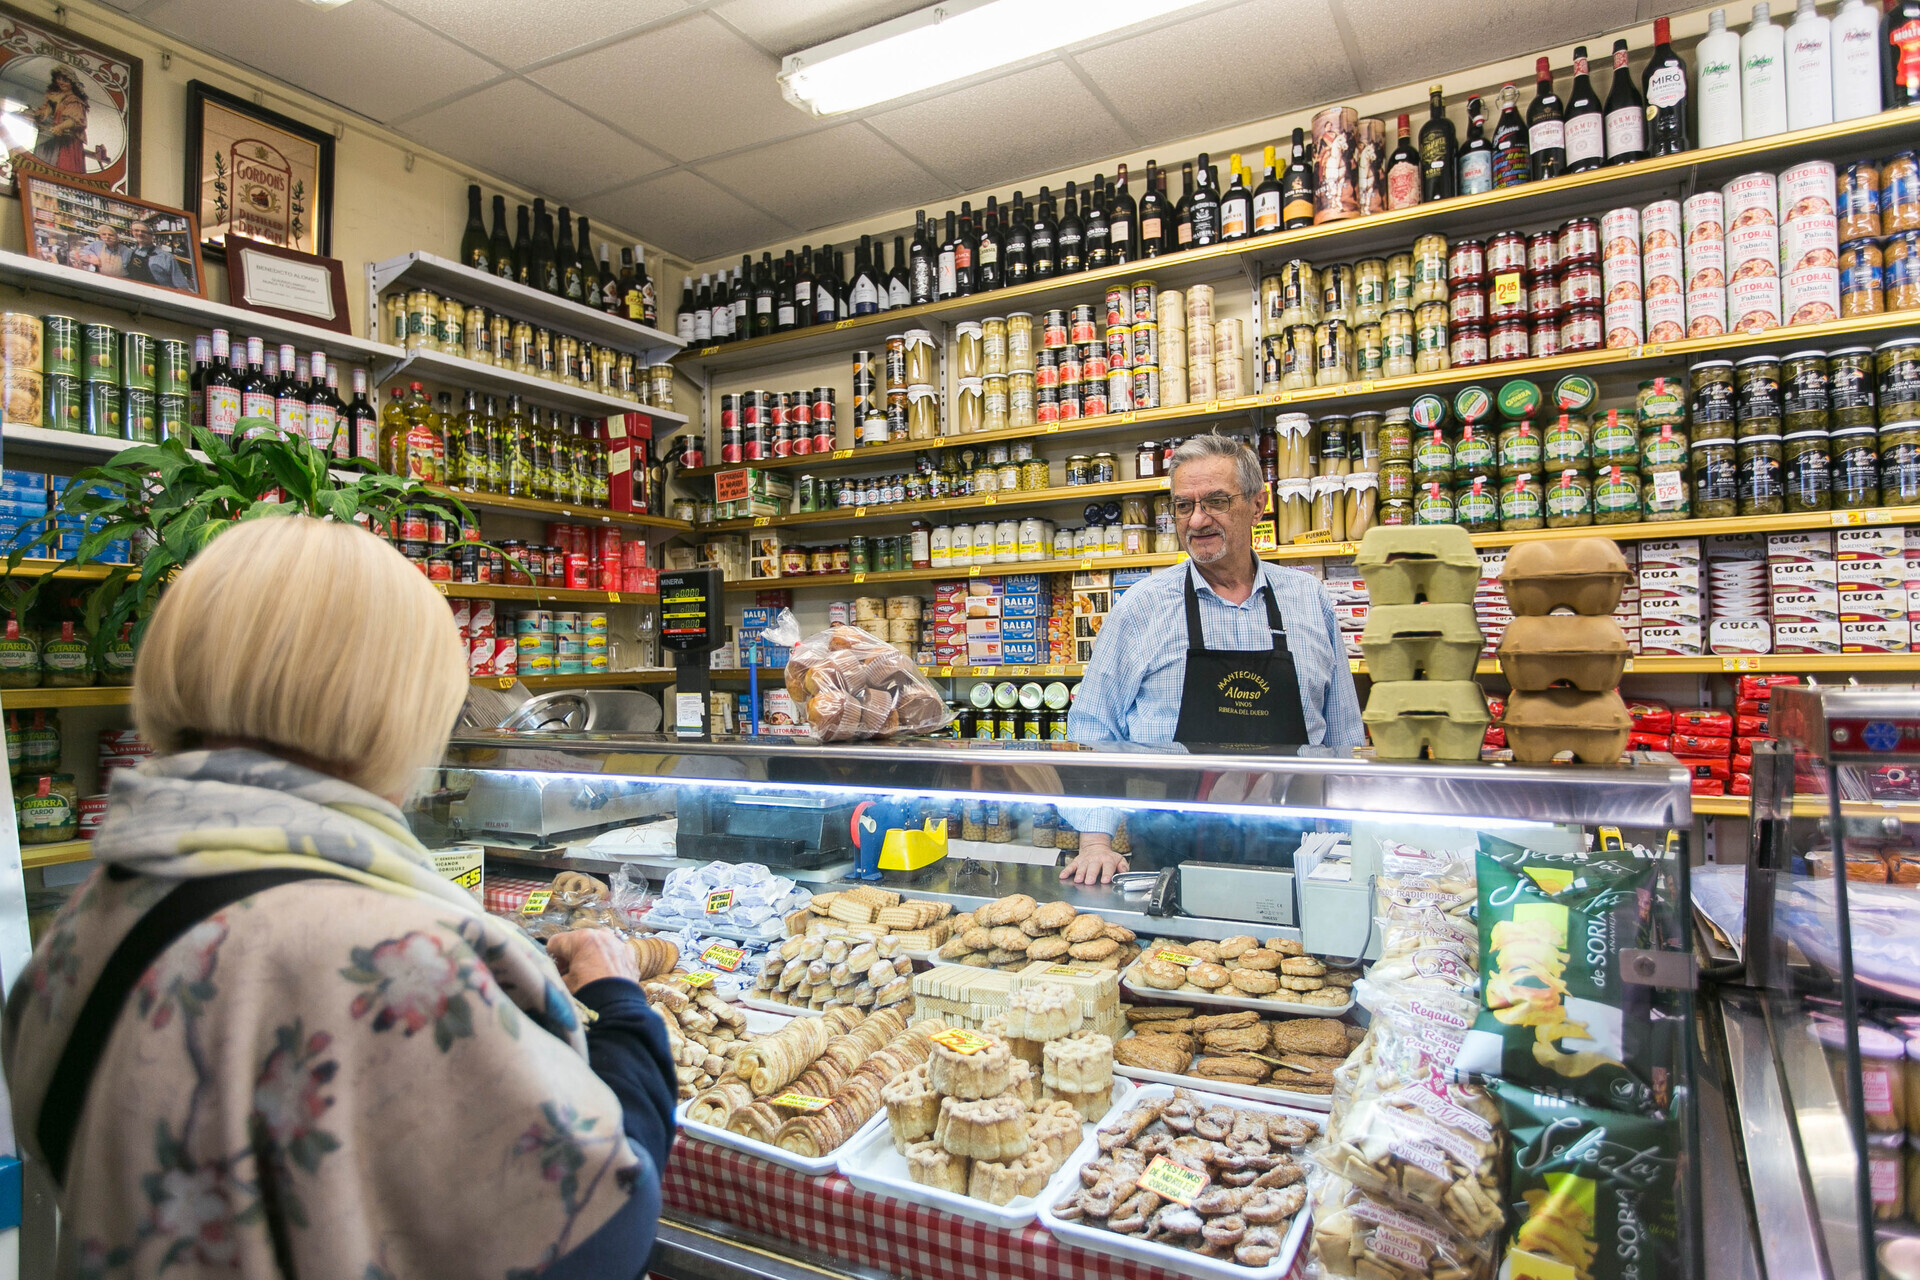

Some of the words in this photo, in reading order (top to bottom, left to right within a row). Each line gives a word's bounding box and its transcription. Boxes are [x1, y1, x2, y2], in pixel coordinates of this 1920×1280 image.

[1652, 73, 1681, 88] MIRÓ
[237, 160, 285, 191] GORDON'S
[1786, 167, 1829, 182] LITORAL
[1731, 178, 1771, 192] LITORAL
[1690, 197, 1721, 208] LITORAL
[240, 209, 283, 230] DISTILLED
[1796, 219, 1835, 231] LITORAL
[239, 220, 262, 237] DRY
[263, 228, 283, 245] GIN
[1732, 230, 1773, 244] LITORAL
[1691, 244, 1722, 255] LITORAL
[1790, 272, 1832, 286] LITORAL
[1734, 282, 1775, 295] LITORAL
[1648, 297, 1679, 309] LITORAL
[1687, 292, 1719, 303] LITORAL
[1305, 530, 1331, 539] PUERROS
[1769, 535, 1811, 545] CUCA
[1839, 531, 1882, 540] CUCA
[1643, 543, 1680, 551] CUCA
[1116, 567, 1149, 575] BALEA
[1774, 565, 1815, 574] CUCA
[1839, 562, 1882, 571] CUCA
[1007, 575, 1037, 583] BALEA
[1642, 571, 1679, 579] CUCA
[661, 578, 684, 586] MINERVA
[1004, 598, 1034, 606] BALEA
[1776, 595, 1816, 604] CUCA
[1842, 593, 1884, 602] CUCA
[1643, 600, 1680, 608] CUCA
[744, 610, 766, 618] BALEA
[1003, 621, 1032, 629] BALEA
[1720, 622, 1759, 630] CUCA
[1778, 626, 1819, 634] CUCA
[1844, 624, 1887, 632] CUCA
[1644, 628, 1681, 637] CUCA
[1004, 645, 1034, 653] BALEA
[1013, 667, 1029, 675] 275
[1217, 670, 1271, 694] MANTEQUERÍA
[1224, 686, 1261, 700] Alonso
[1219, 706, 1238, 715] RIBERA
[30, 808, 54, 816] CARDO
[1397, 888, 1463, 903] TRADICIONALES
[1587, 910, 1607, 967] SORIA
[1589, 972, 1605, 987] de
[1405, 1037, 1432, 1057] Pan
[1428, 1105, 1490, 1140] Moriles
[1425, 1120, 1458, 1145] Tradicional
[1458, 1138, 1473, 1151] con
[1517, 1116, 1662, 1187] Selectas
[1148, 1167, 1160, 1178] DE
[1379, 1214, 1396, 1225] Oliva
[1397, 1219, 1418, 1234] Virgen
[1420, 1228, 1439, 1241] Extra
[1398, 1212, 1435, 1230] Tradicional
[1435, 1227, 1448, 1238] con
[1616, 1188, 1639, 1260] SORIA
[1377, 1228, 1419, 1250] Moriles
